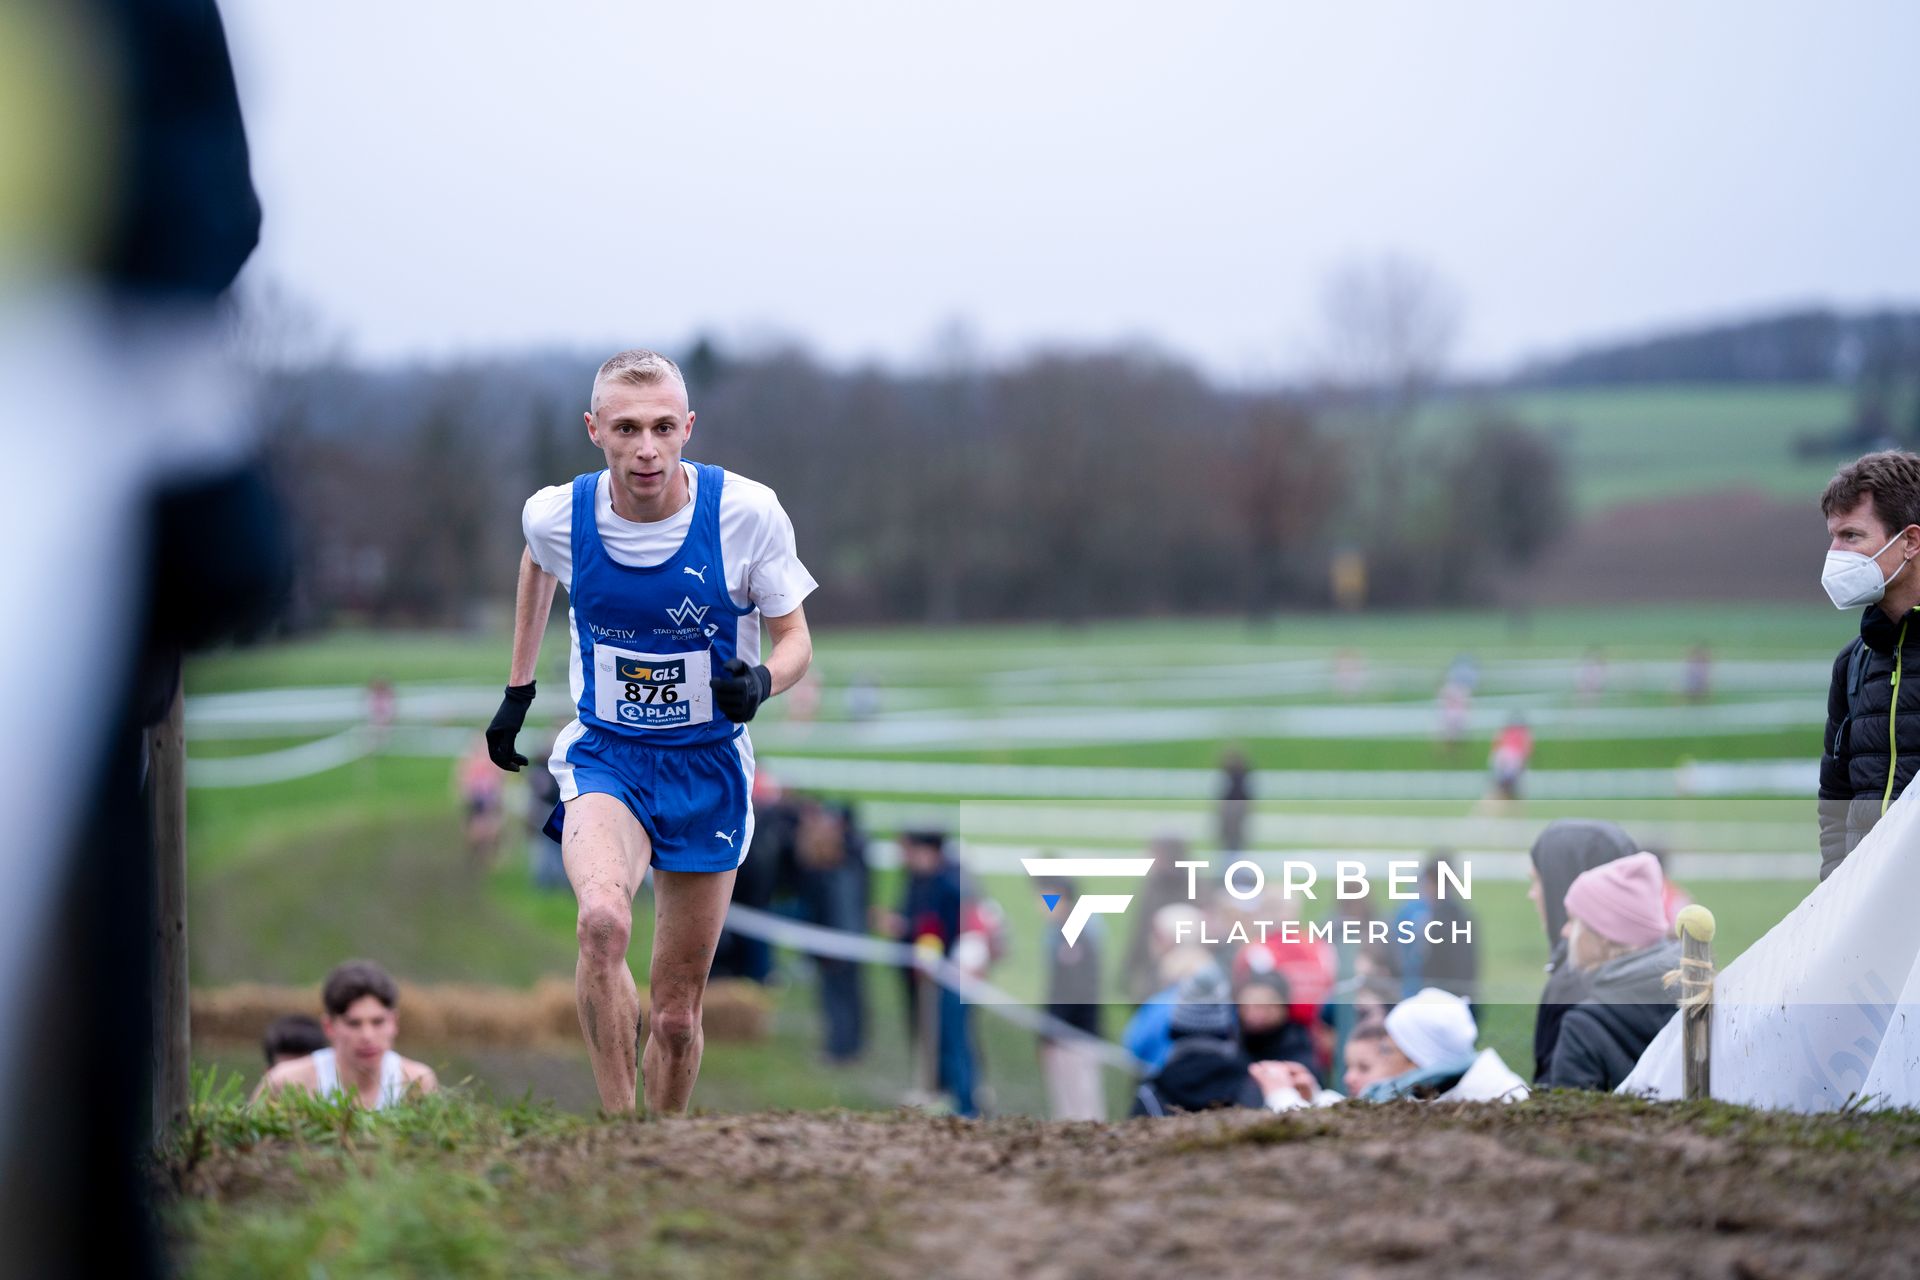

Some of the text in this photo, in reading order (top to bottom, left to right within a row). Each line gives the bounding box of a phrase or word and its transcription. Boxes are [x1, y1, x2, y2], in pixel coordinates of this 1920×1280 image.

[589, 622, 635, 638] VIACTIV
[653, 628, 701, 636] STADTWERKE
[671, 633, 702, 641] BOCHUM
[652, 667, 679, 681] GLS
[624, 682, 678, 704] 876
[646, 705, 687, 718] PLAN
